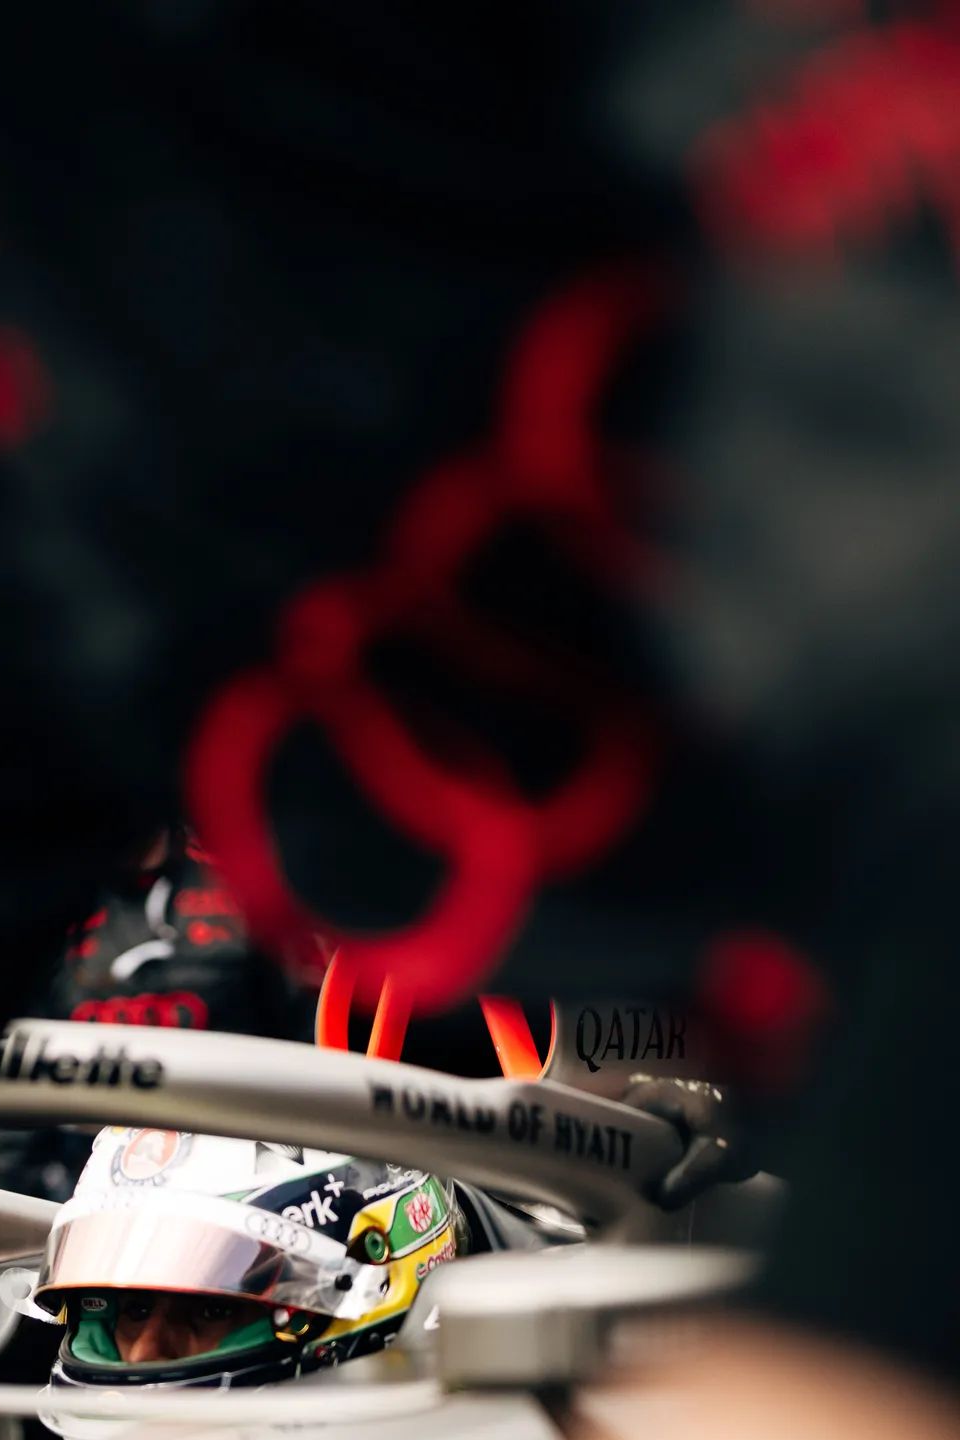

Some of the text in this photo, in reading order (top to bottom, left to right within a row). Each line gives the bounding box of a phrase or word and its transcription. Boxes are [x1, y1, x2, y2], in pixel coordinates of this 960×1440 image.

[575, 1005, 688, 1073] QATAR
[367, 1085, 635, 1170] WORLD OF HYATT
